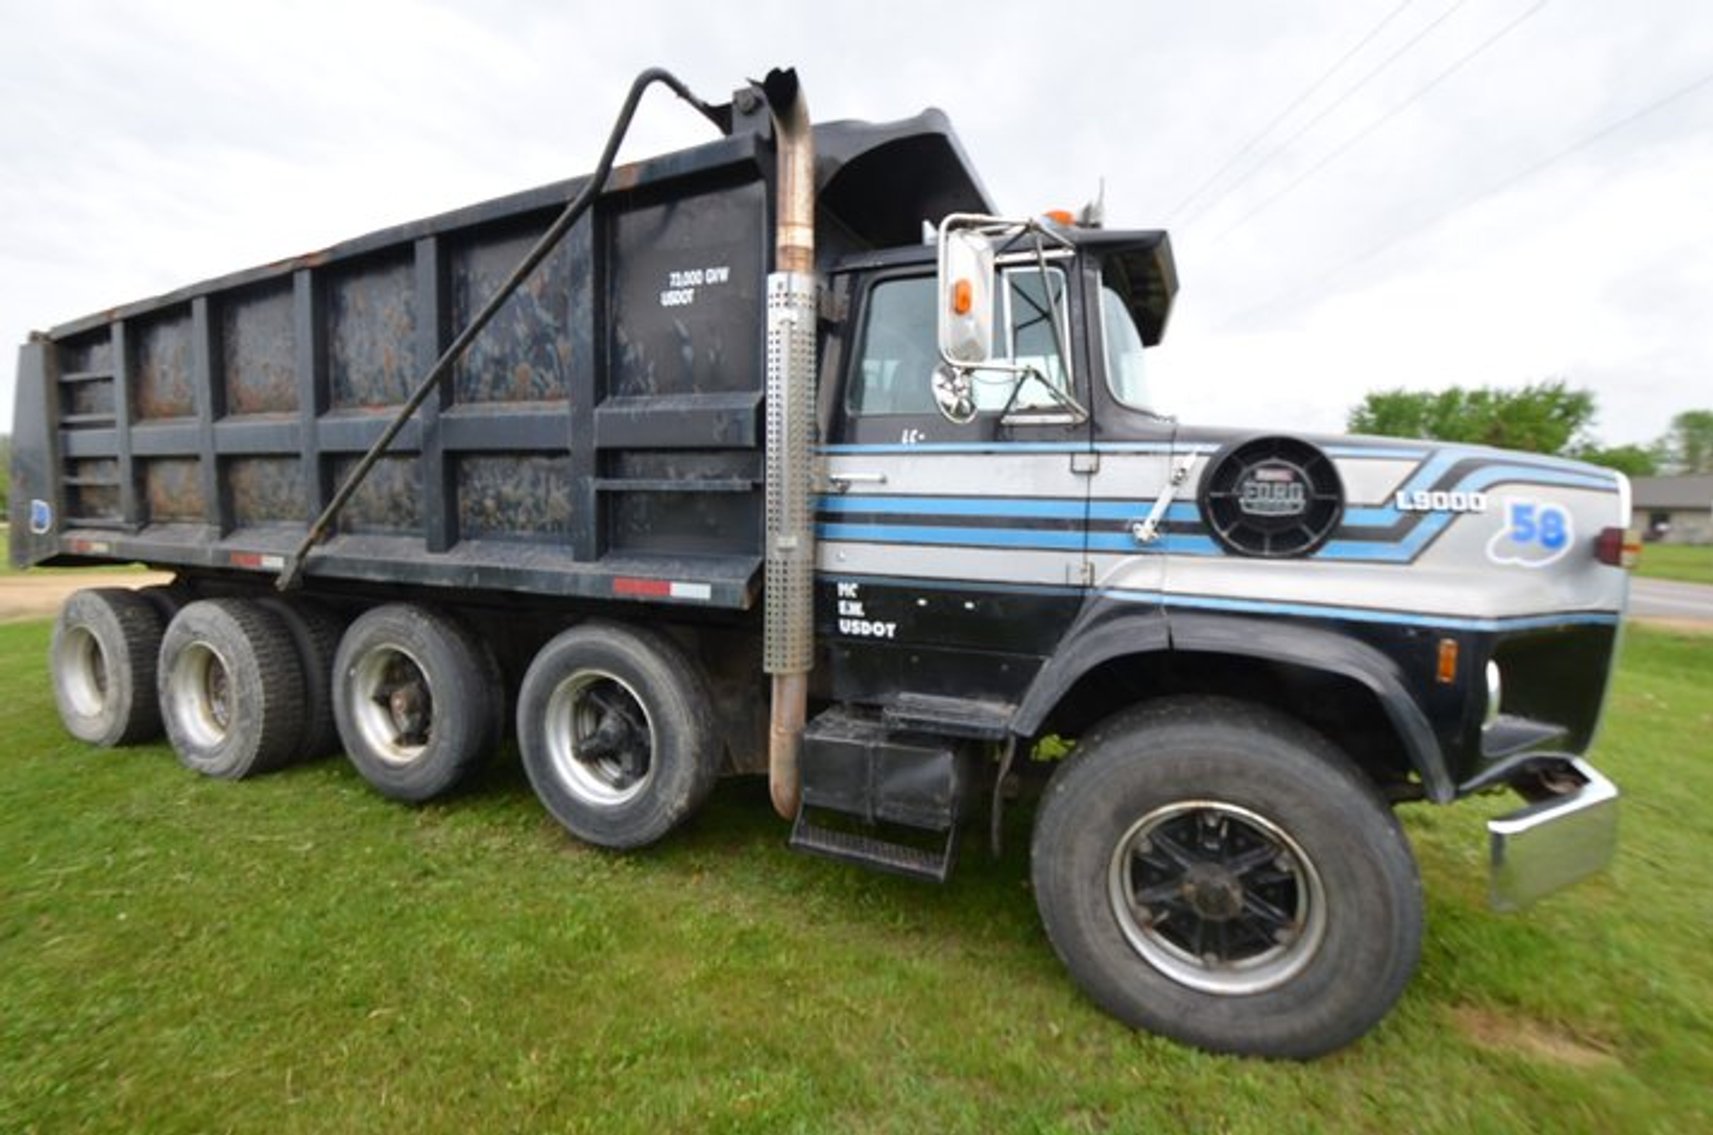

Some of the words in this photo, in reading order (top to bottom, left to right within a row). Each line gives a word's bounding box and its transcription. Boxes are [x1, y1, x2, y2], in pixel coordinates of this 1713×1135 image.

[660, 288, 695, 306] USDOT
[1396, 491, 1488, 512] L9000
[1510, 503, 1567, 549] 58
[839, 618, 897, 638] USDOT
